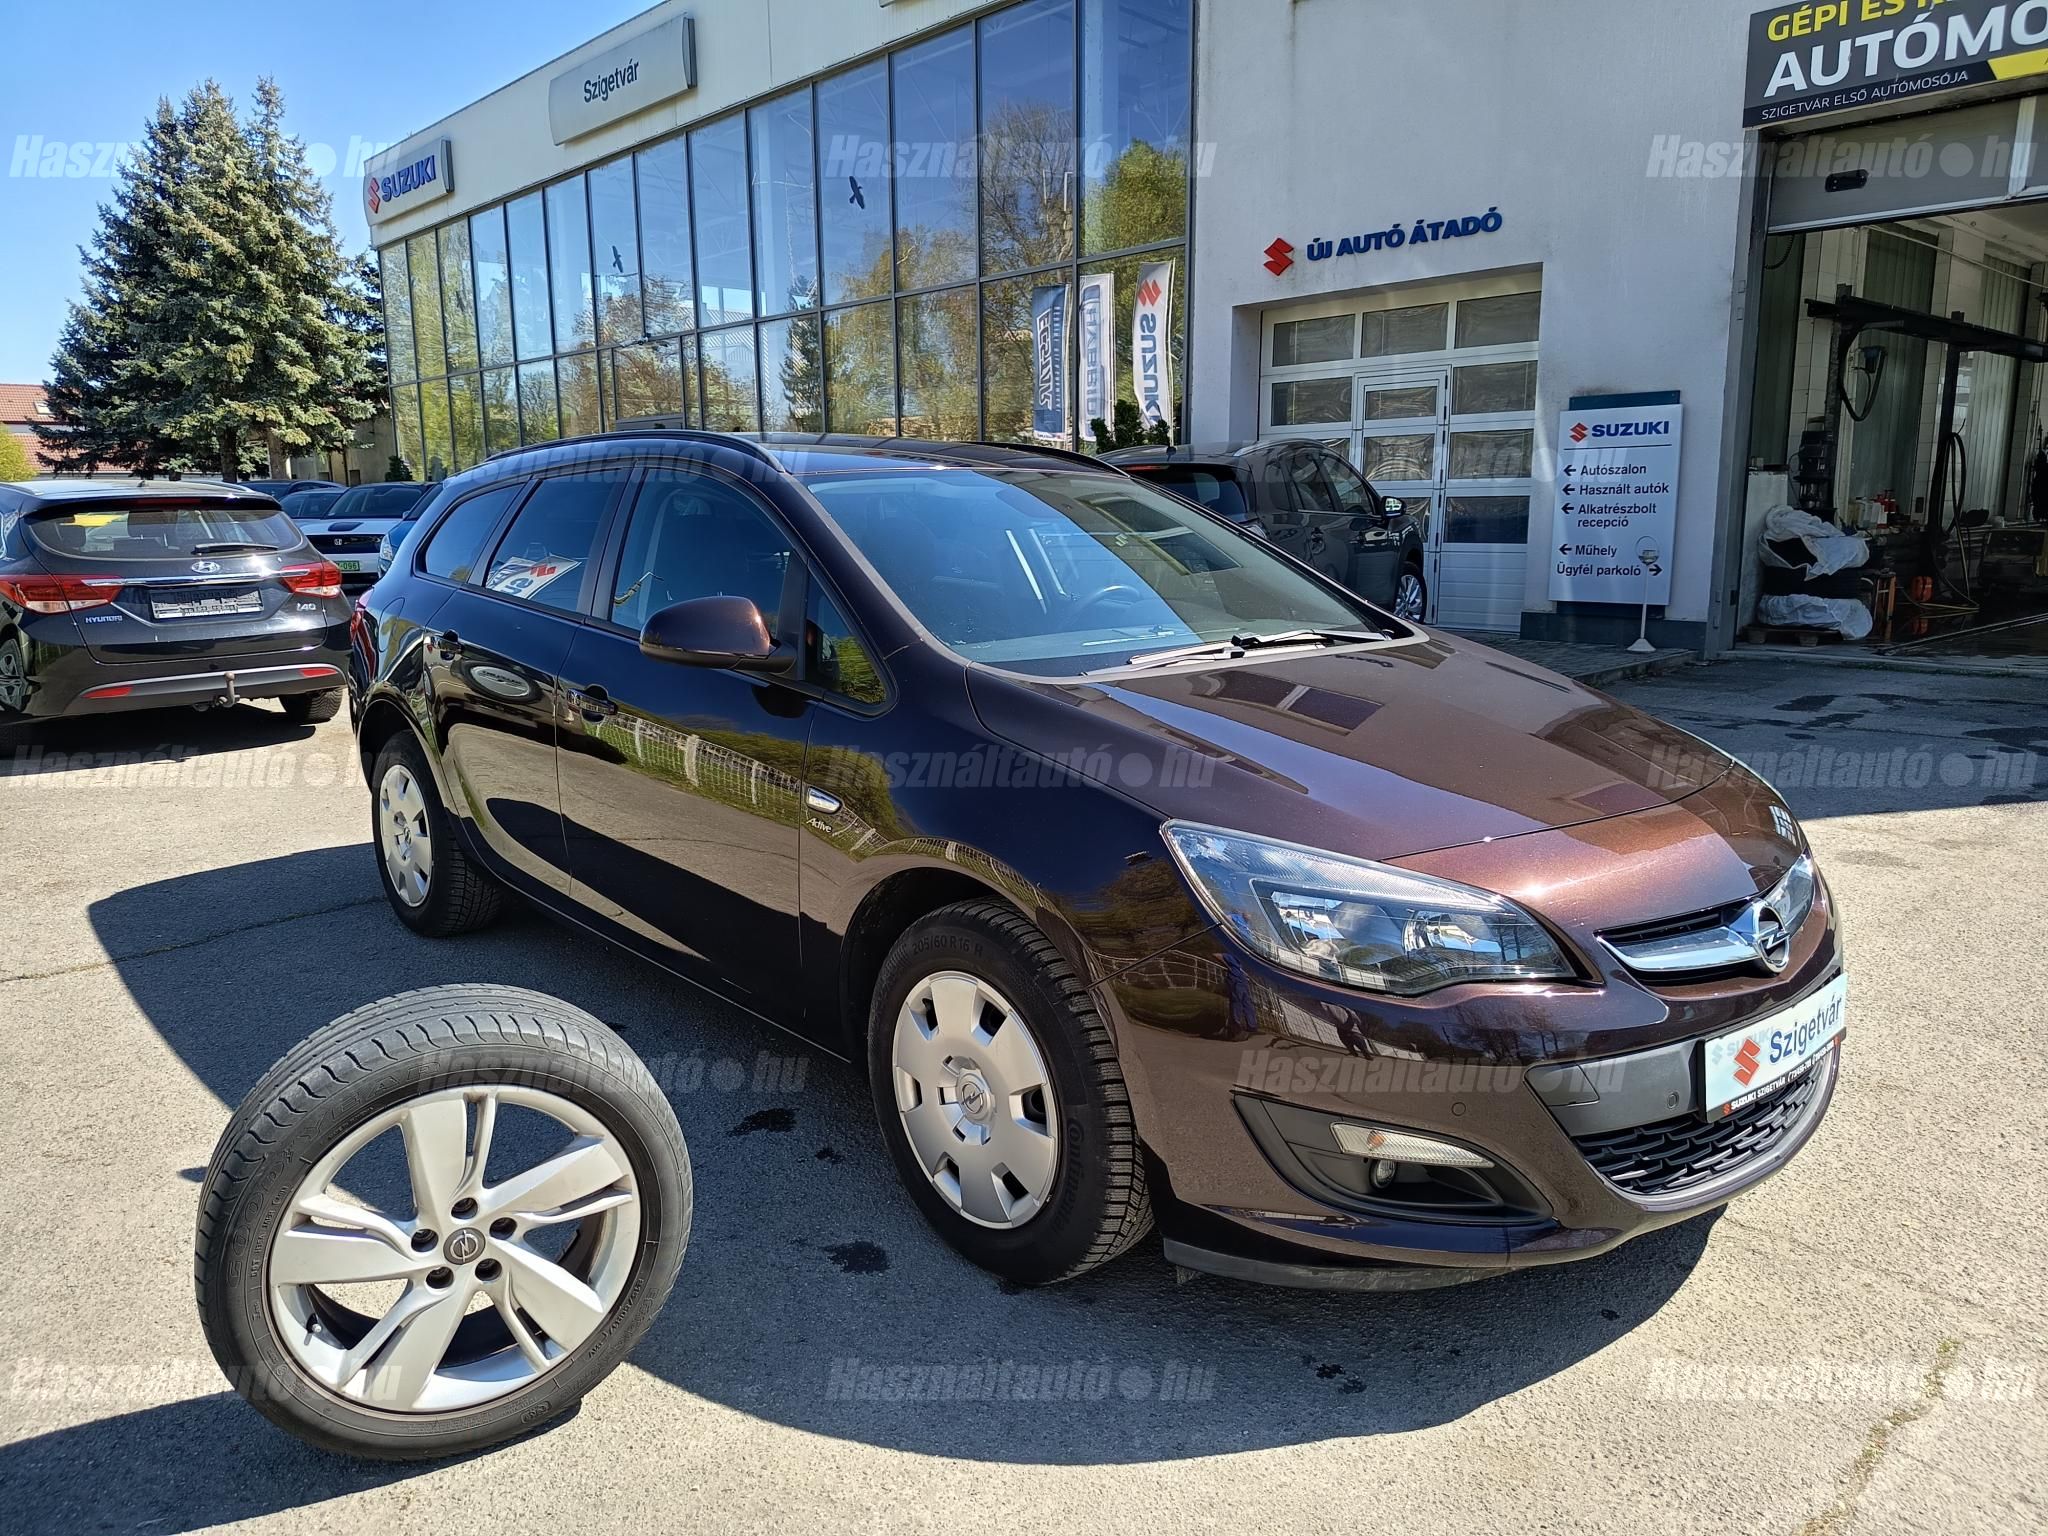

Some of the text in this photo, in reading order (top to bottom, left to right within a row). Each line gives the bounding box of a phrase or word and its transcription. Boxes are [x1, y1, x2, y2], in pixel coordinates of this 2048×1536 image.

[1768, 0, 1848, 41] GÉPI
[584, 58, 640, 103] Szigetvár
[1762, 70, 1968, 120] SZIGETVÁR ELSŐ AUTÓMOSÓJA
[381, 155, 436, 202] SUZUKI
[1307, 207, 1503, 261] ÚJ AUTÓ ÁTADÓ
[1591, 421, 1669, 438] SUZUKI
[1580, 464, 1647, 477] Autószalon
[1579, 482, 1670, 496] Használt autók
[1578, 502, 1657, 515] Alkatrészbolt
[1577, 516, 1629, 529] recepció
[1575, 543, 1617, 558] Műhely
[1557, 563, 1641, 577] Ügyfél parkoló
[85, 614, 123, 624] HYUNDAI
[807, 817, 832, 833] Active
[1769, 992, 1842, 1064] Szigetvár
[1731, 1077, 1785, 1109] SUZUKI SZIGETVÁR
